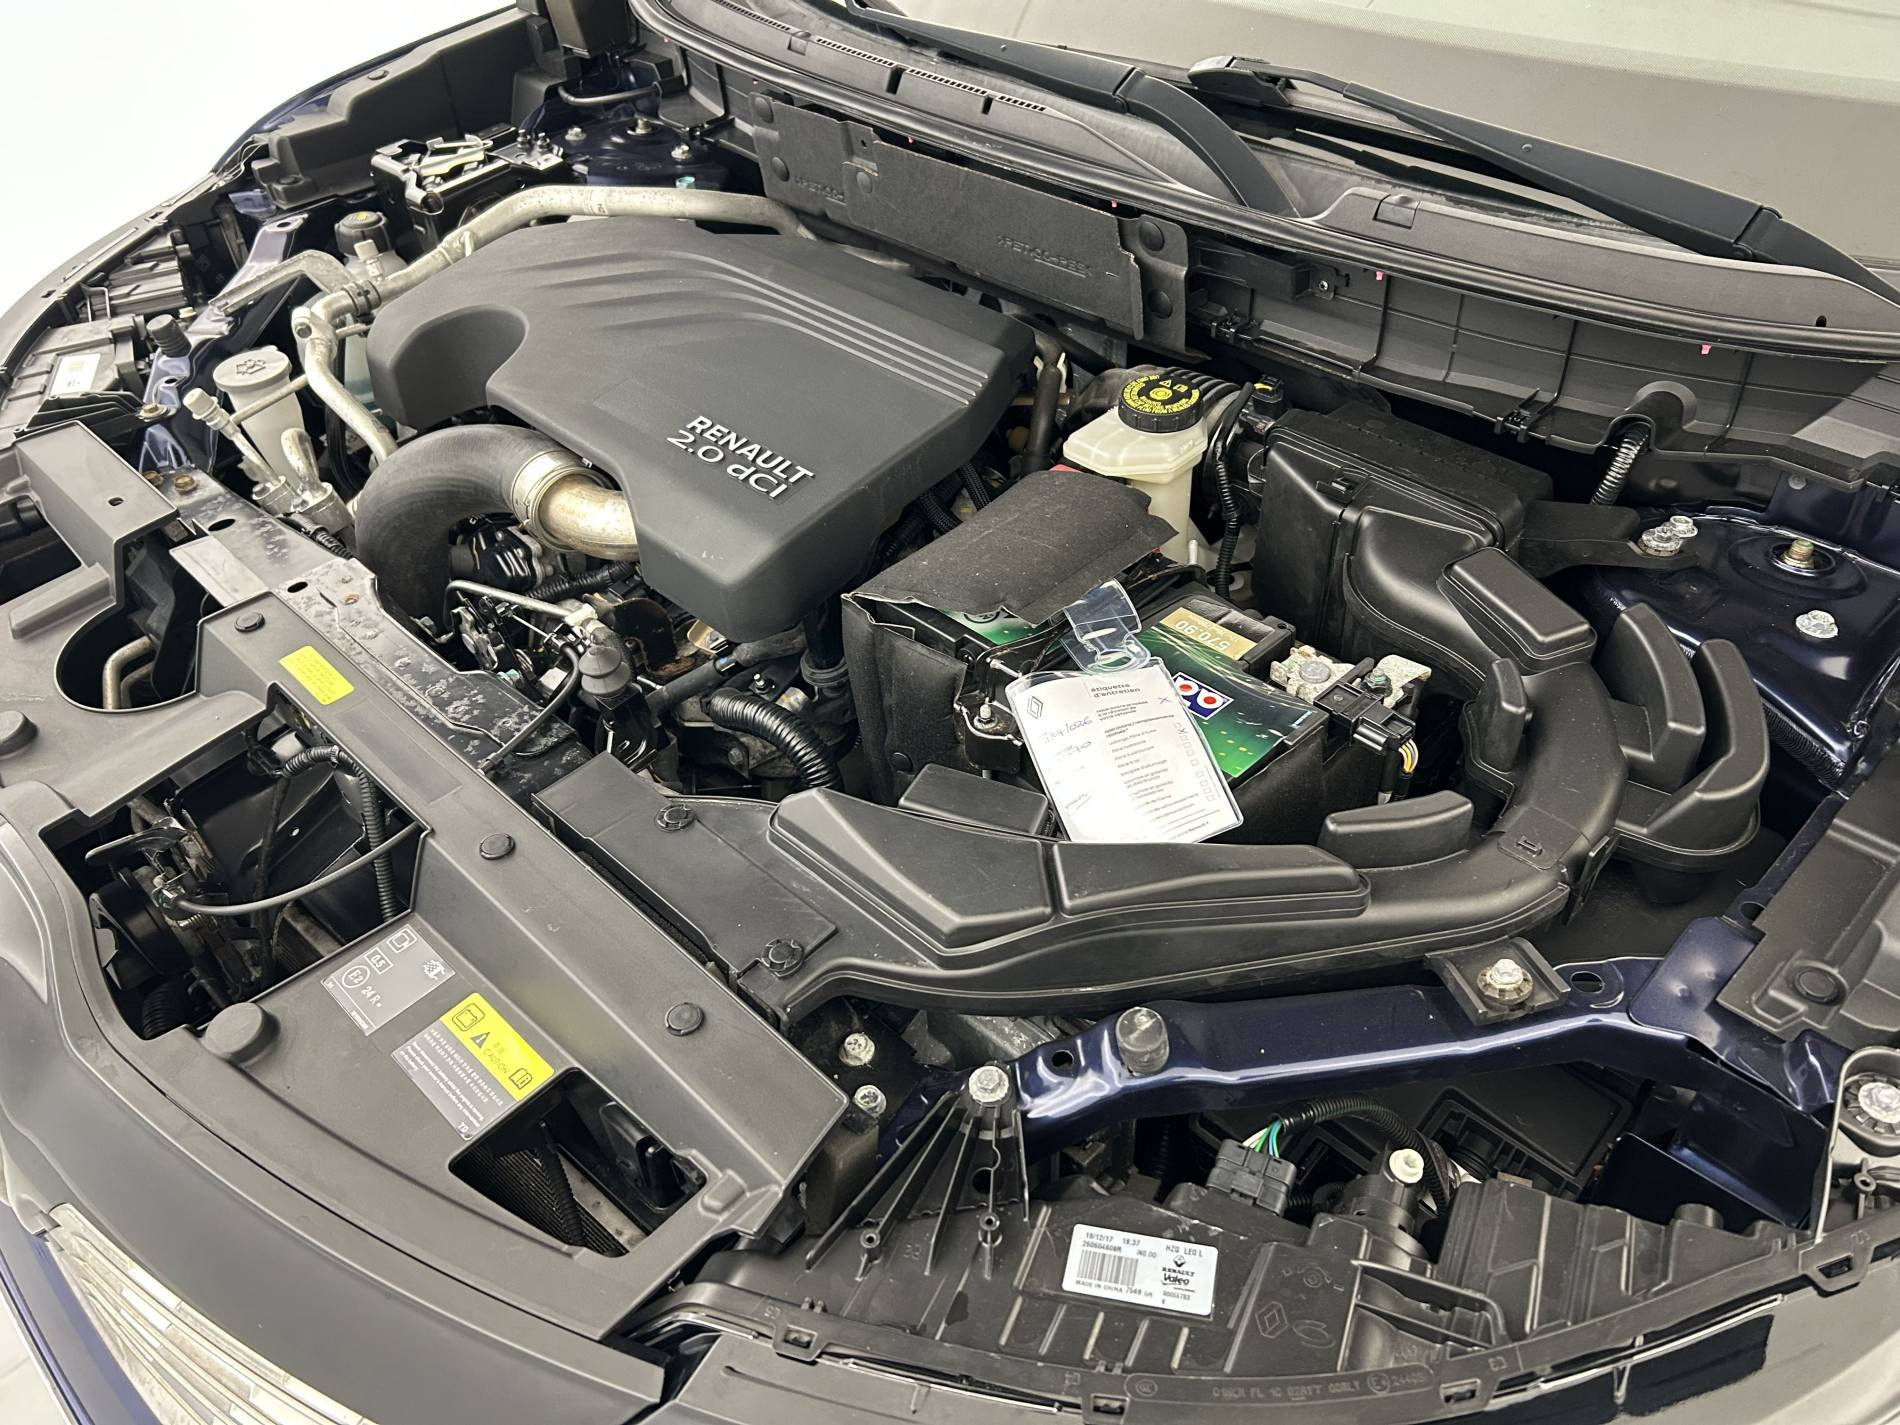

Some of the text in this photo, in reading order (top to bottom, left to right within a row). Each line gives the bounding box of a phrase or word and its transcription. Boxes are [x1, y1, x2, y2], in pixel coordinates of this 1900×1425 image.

[686, 415, 815, 484] RENAULT
[483, 1048, 511, 1074] CAUTION
[1162, 1266, 1195, 1277] RENAULT
